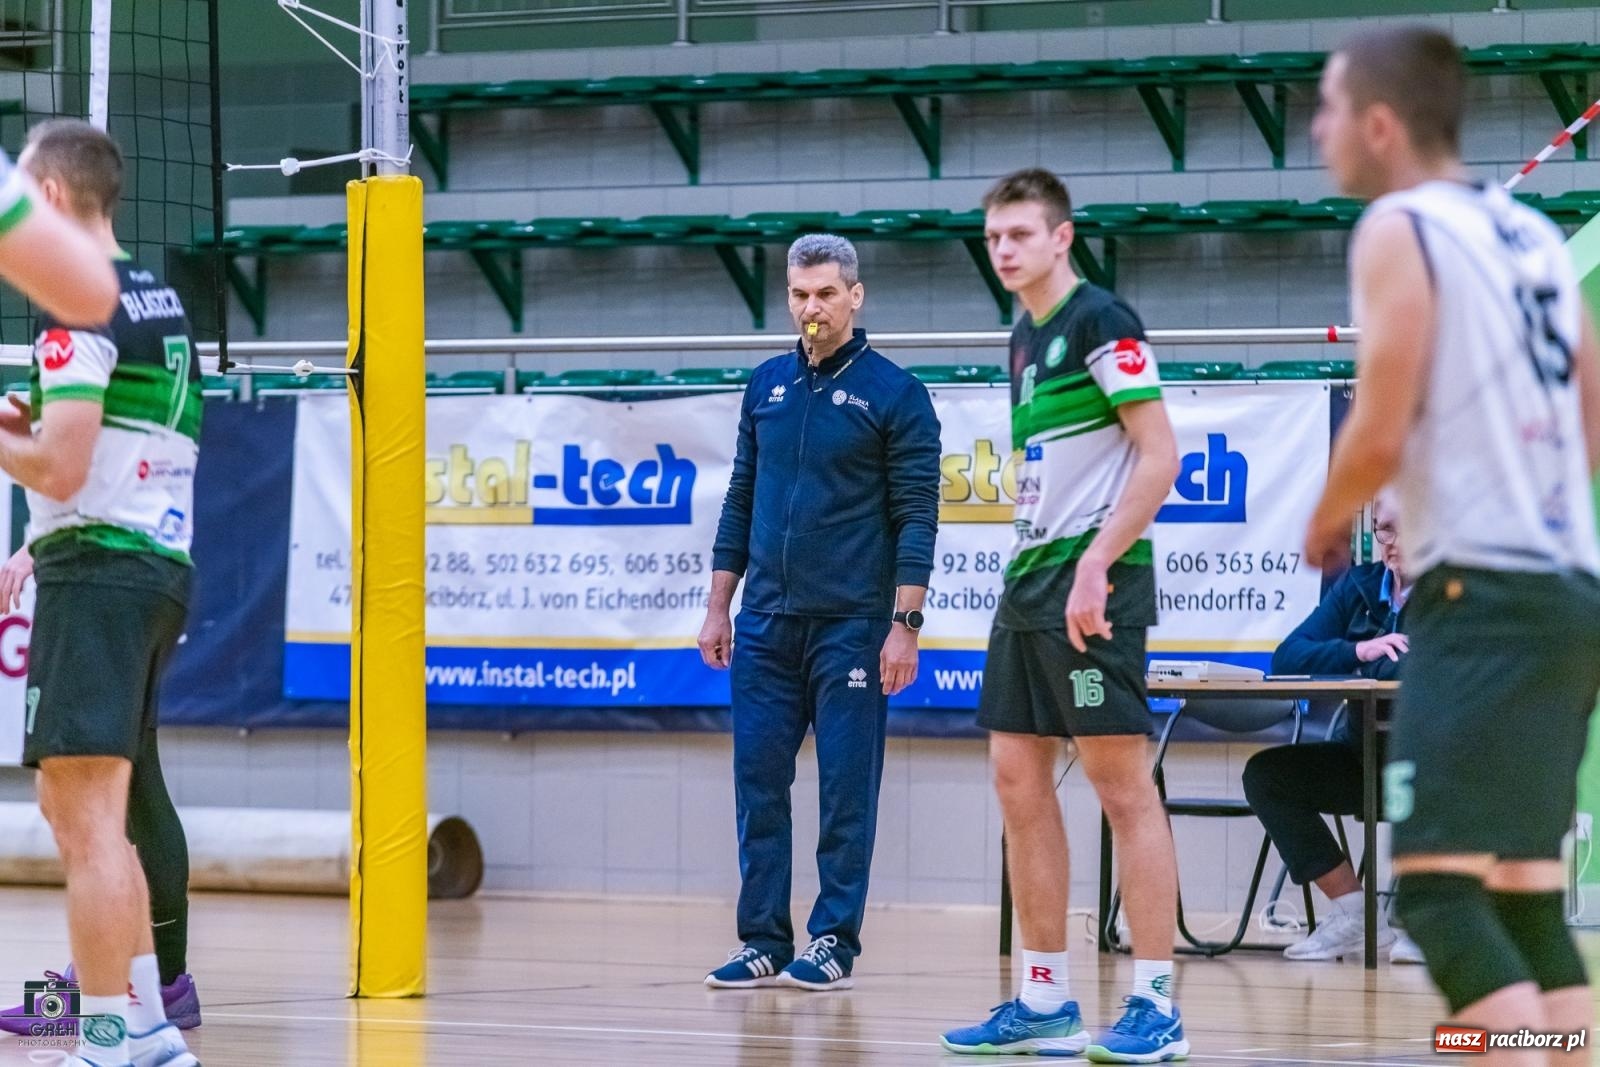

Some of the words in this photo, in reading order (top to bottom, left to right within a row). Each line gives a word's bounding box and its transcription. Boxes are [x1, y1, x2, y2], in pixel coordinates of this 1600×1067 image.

[163, 335, 190, 431] 7
[425, 439, 697, 508] stal-tech
[486, 552, 518, 575] 502
[524, 551, 562, 575] 632
[624, 552, 659, 574] 606
[664, 551, 703, 575] 363
[942, 552, 967, 574] 92
[1166, 551, 1208, 573] 606
[1215, 551, 1253, 574] 363
[1261, 551, 1301, 574] 647
[539, 592, 578, 609] von
[1274, 589, 1286, 611] 2
[1069, 669, 1105, 708] 16
